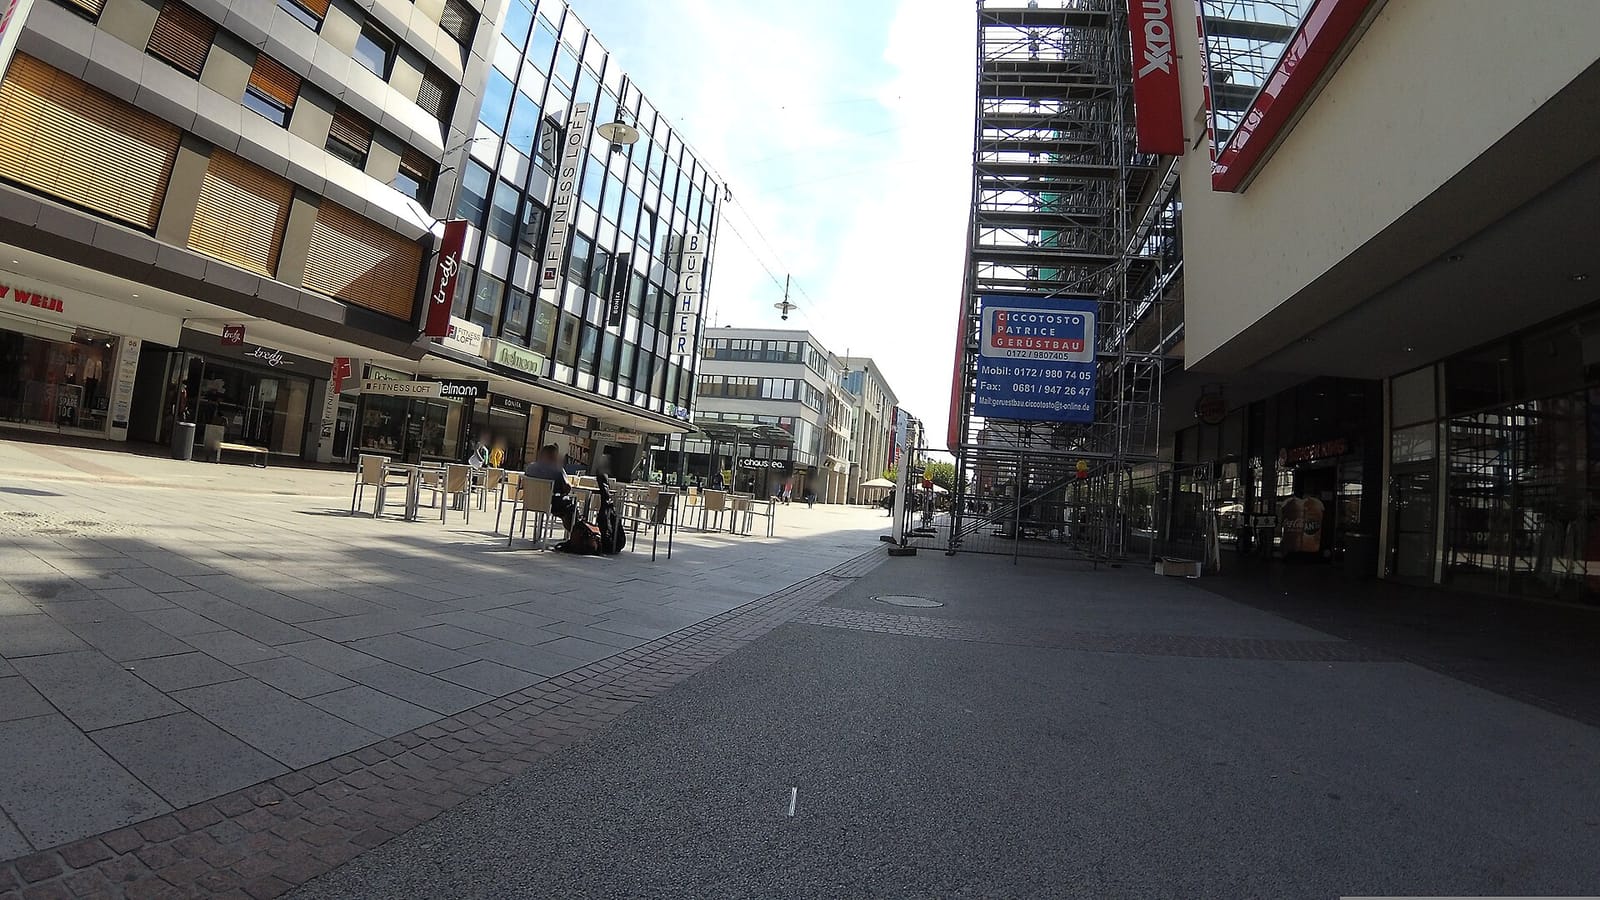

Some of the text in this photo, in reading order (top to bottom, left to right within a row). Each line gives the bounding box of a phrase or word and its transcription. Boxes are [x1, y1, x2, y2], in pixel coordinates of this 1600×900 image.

[547, 107, 587, 262] FITNESS LOFT
[434, 251, 458, 304] tredy
[677, 235, 697, 353] BÜCHER
[998, 313, 1081, 325] CICCOTOSTO
[456, 328, 481, 346] FITNESS LOFT
[997, 325, 1056, 336] PATRICE
[996, 337, 1080, 350] GERÜSTBAU
[254, 346, 285, 367] tredy
[1006, 349, 1027, 358] 0172
[1033, 351, 1069, 360] 9807405
[981, 365, 1092, 381] Mobil: 0172 / 980 74 05
[372, 382, 431, 393] FITNESS LOFT
[980, 381, 1091, 397] Fax: 0681 / 947 26 47
